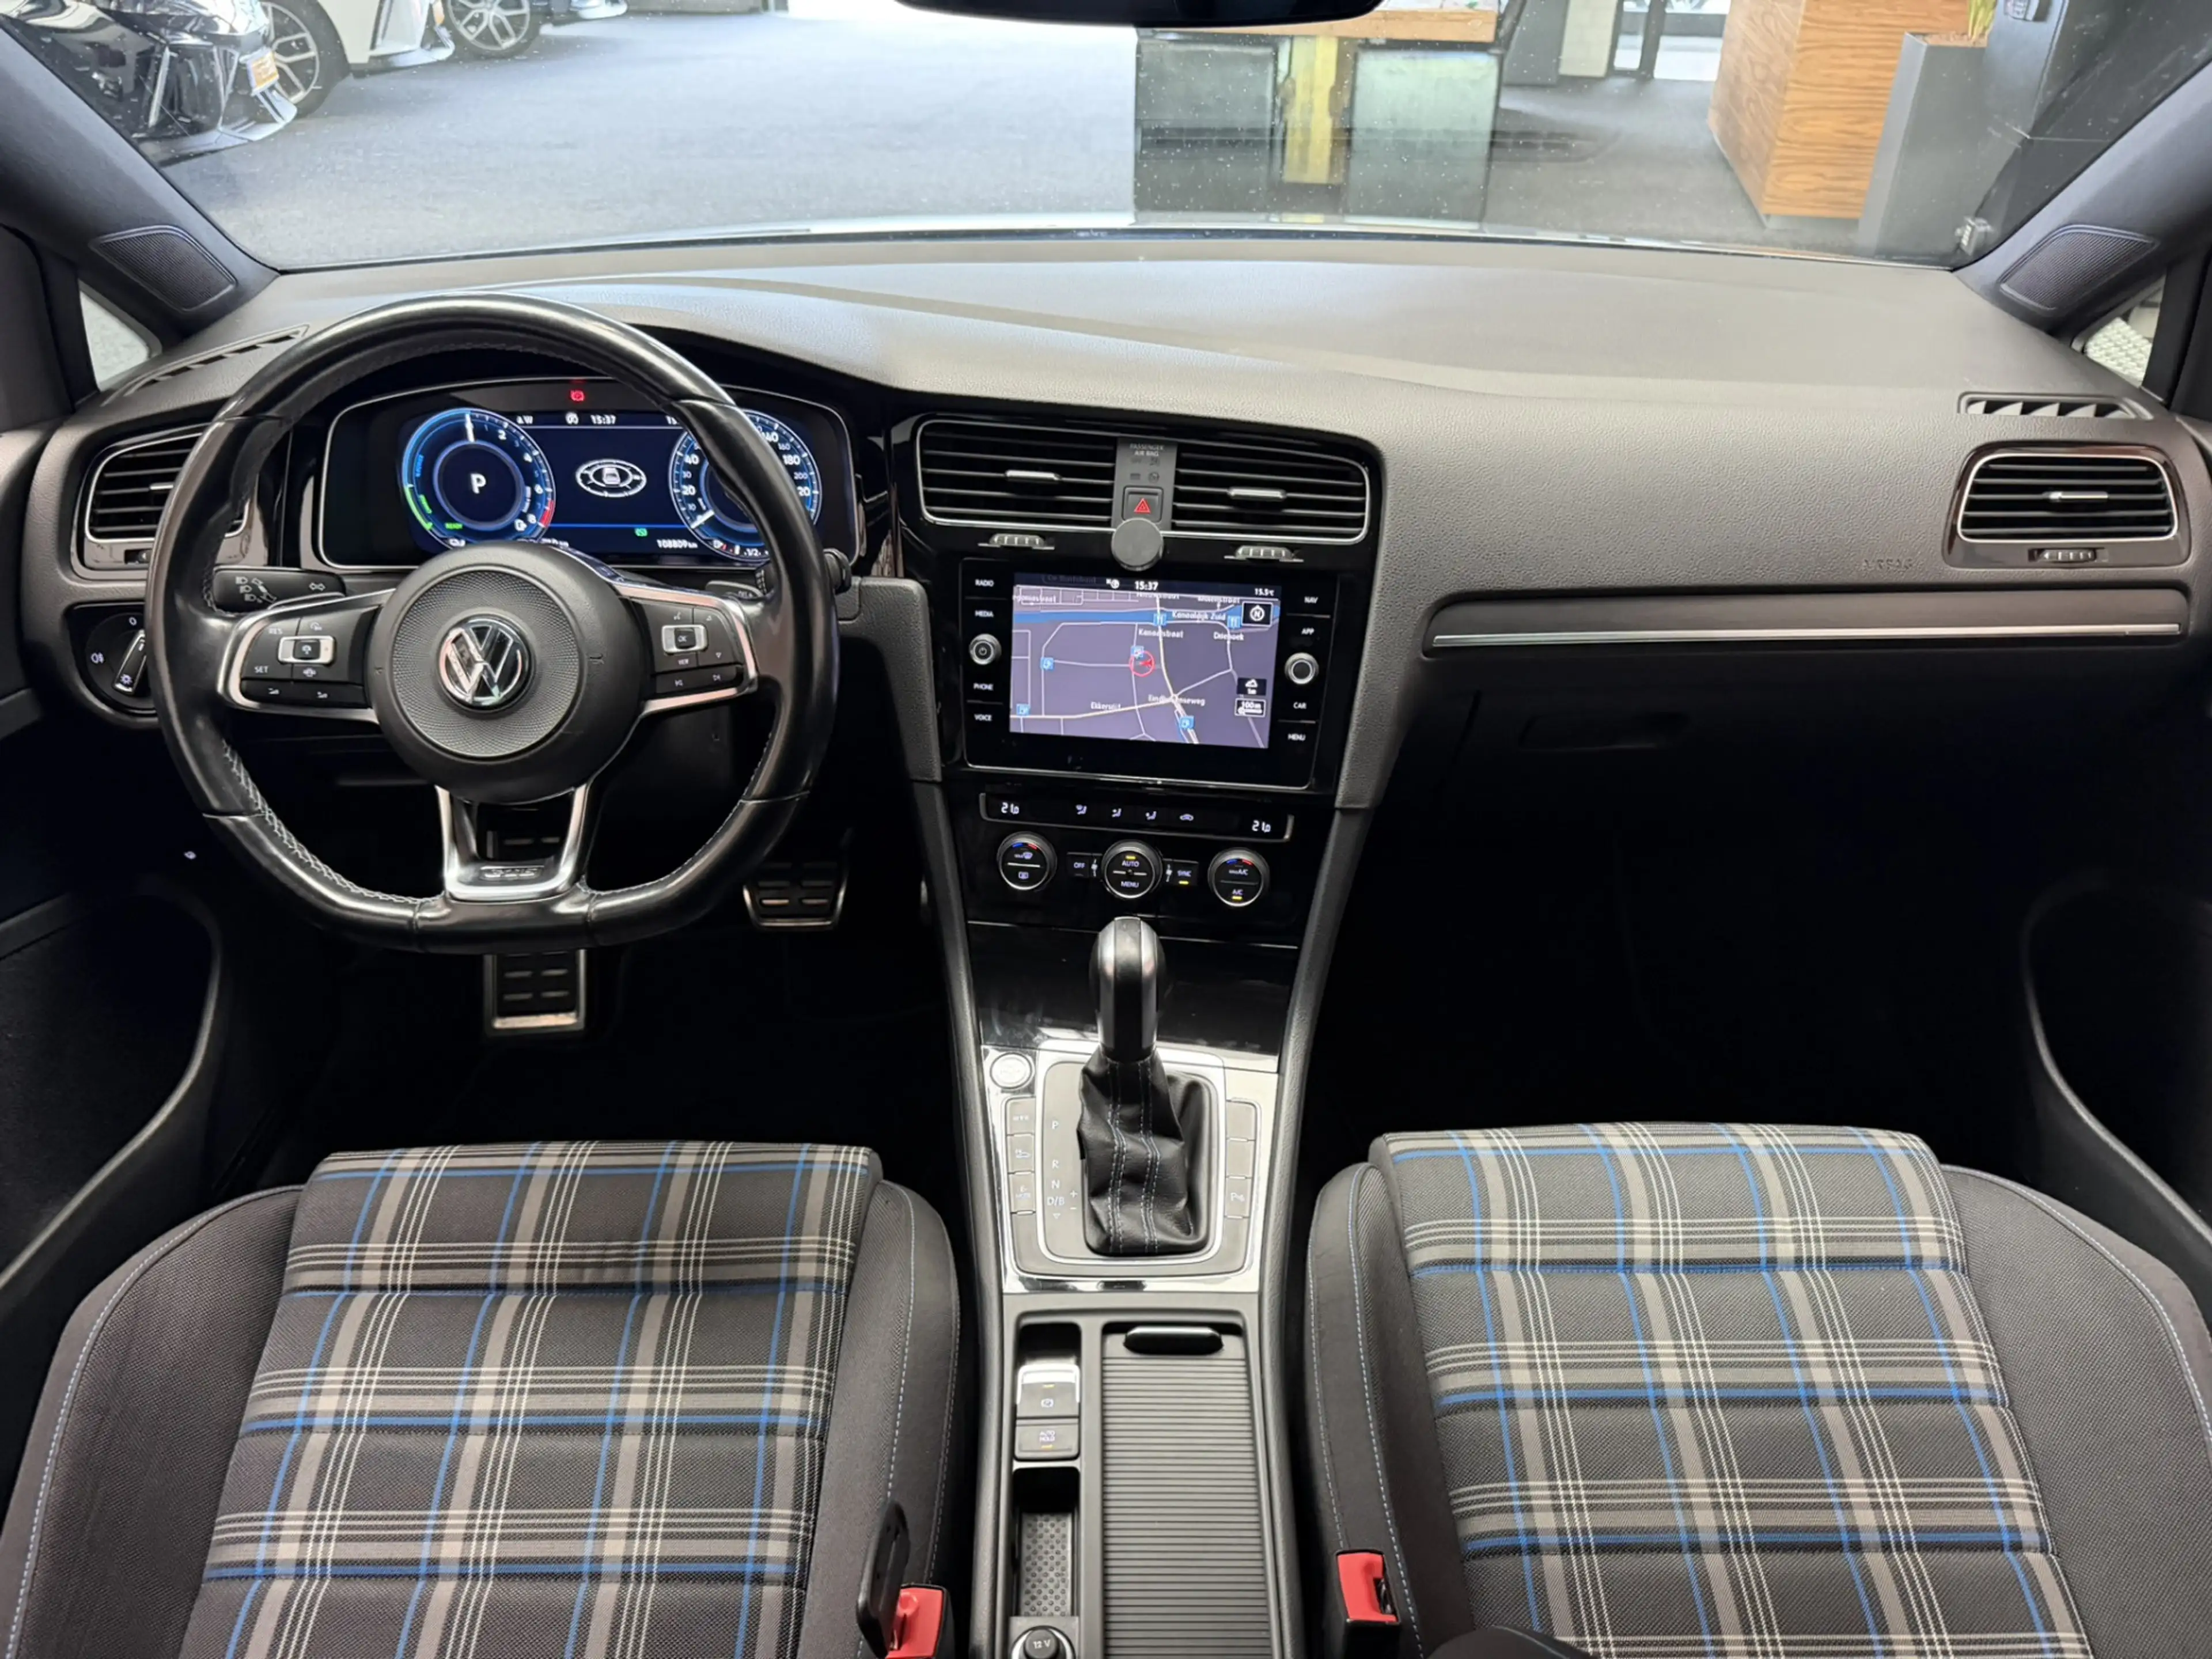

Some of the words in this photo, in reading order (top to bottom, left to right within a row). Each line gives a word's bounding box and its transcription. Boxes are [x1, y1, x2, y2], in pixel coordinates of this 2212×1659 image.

[590, 415, 616, 425] 15:37
[498, 430, 507, 440] 2
[762, 433, 778, 442] 40
[685, 454, 699, 465] 40
[782, 454, 800, 465] 180
[470, 474, 486, 494] P
[681, 485, 696, 495] 20
[797, 486, 811, 496] 20
[1134, 581, 1158, 590] 15:37
[1210, 612, 1226, 621] Zuid
[1051, 1120, 1059, 1129] P
[1052, 1159, 1059, 1169] R
[1051, 1180, 1060, 1189] N
[1047, 1196, 1065, 1206] D/B
[1033, 1641, 1042, 1649] 12
[1043, 1639, 1051, 1647] V
